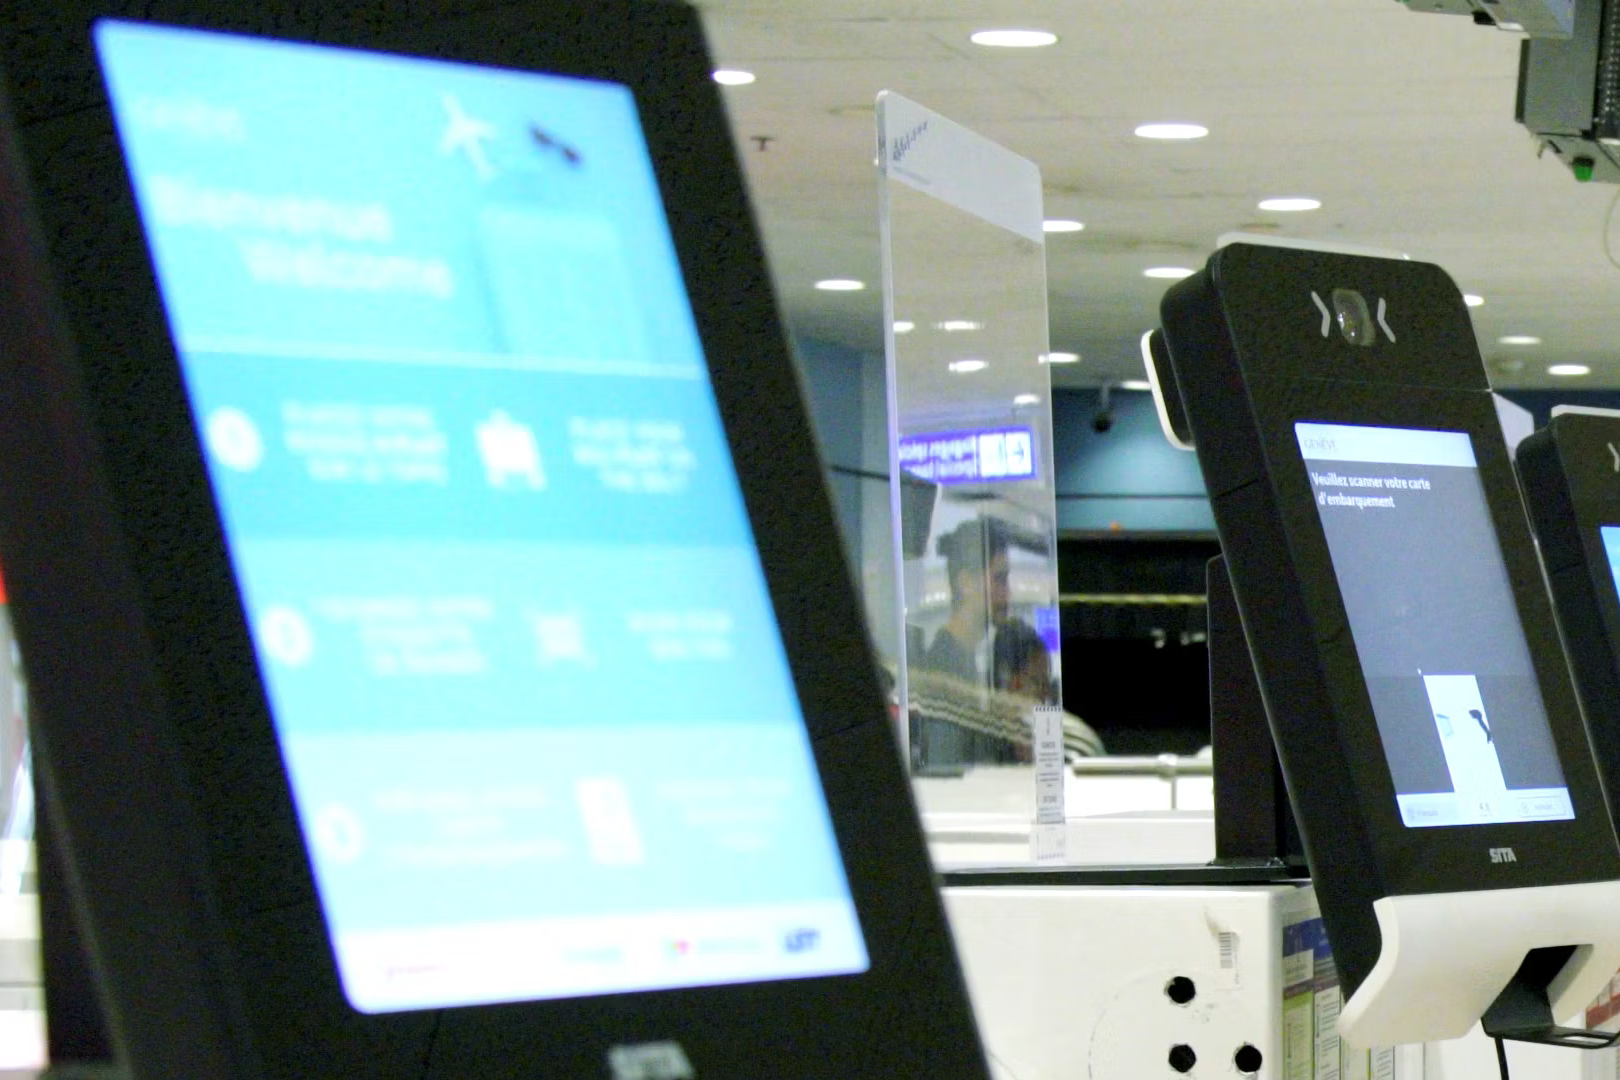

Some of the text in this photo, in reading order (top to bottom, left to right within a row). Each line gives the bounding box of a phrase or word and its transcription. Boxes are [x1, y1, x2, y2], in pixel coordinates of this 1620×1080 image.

[1311, 472, 1431, 490] Veuillez scanner votre carte
[1318, 492, 1395, 509] d'embarquement
[1489, 847, 1517, 863] SITA
